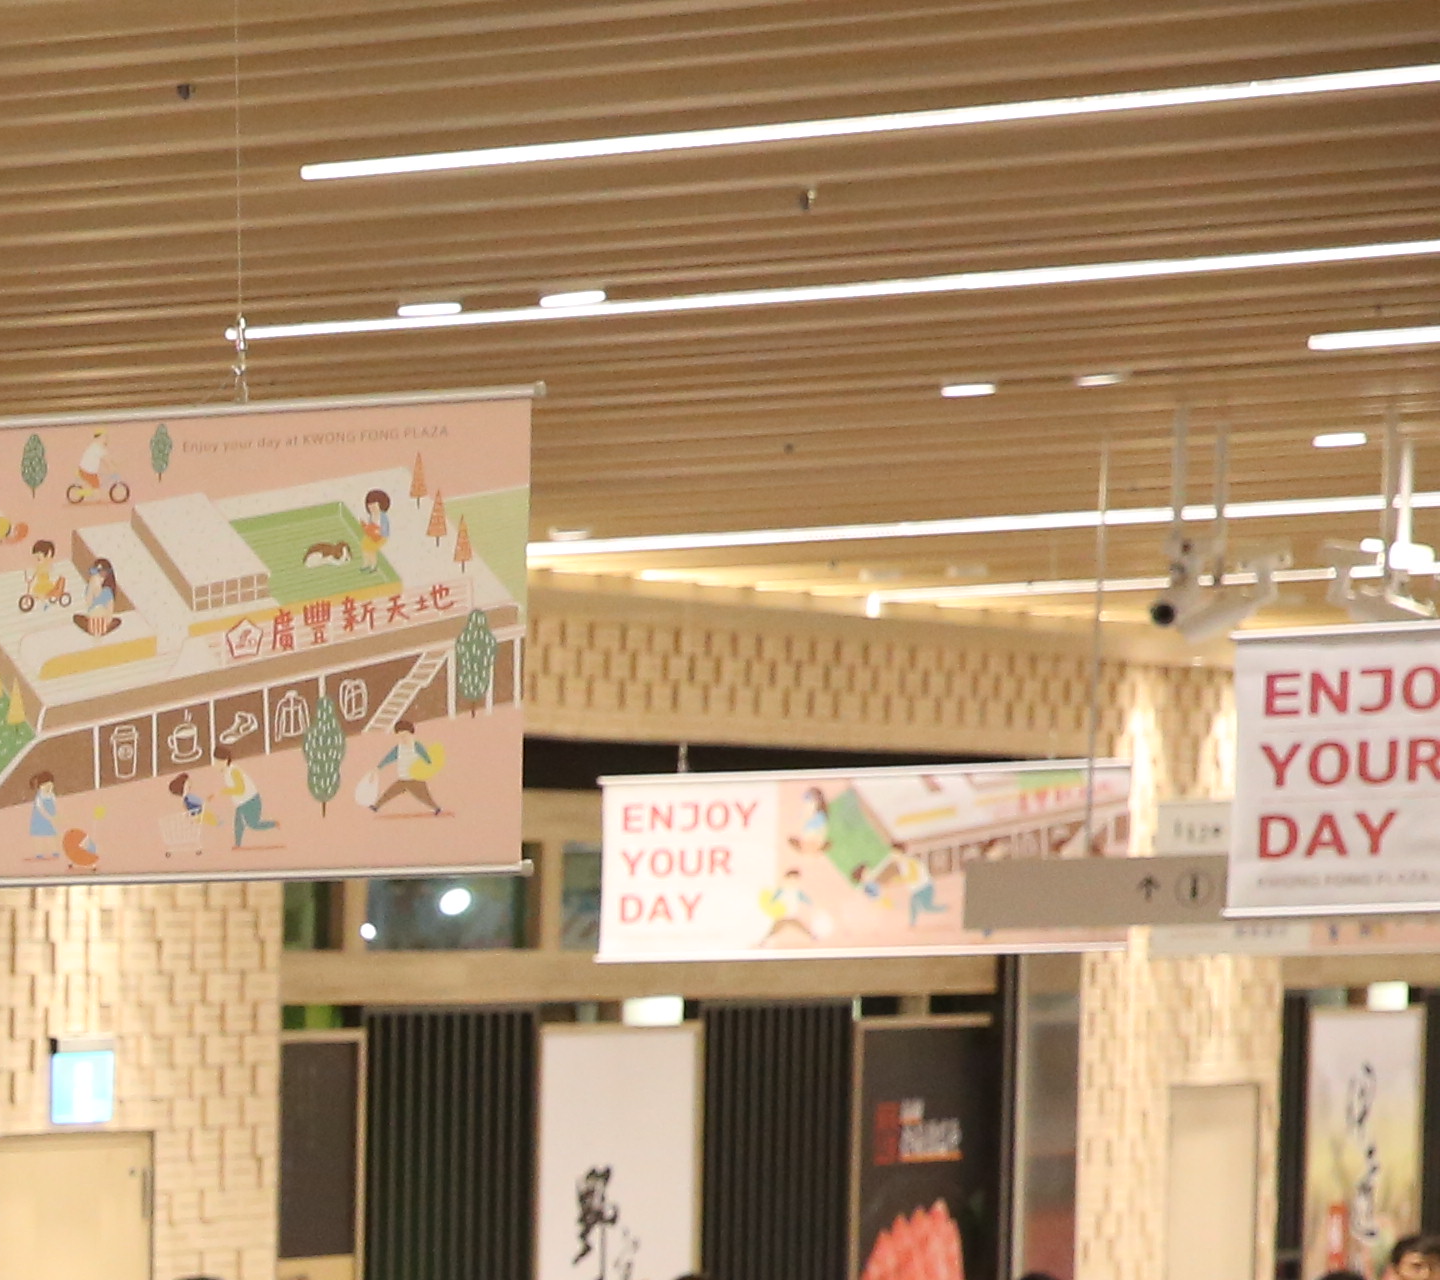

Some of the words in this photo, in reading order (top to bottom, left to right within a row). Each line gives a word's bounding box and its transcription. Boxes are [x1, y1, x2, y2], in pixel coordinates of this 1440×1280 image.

[182, 439, 220, 453] Enjoy
[223, 439, 254, 452] your
[257, 435, 281, 450] day
[285, 436, 298, 446] at
[302, 429, 356, 446] KWONG
[361, 427, 400, 443] FONG
[403, 425, 449, 439] PLAZA
[272, 583, 454, 651] 廣豐新天地
[1260, 735, 1440, 788] YOUR
[621, 800, 759, 834] ENJOY
[1257, 808, 1398, 859] DAY
[620, 846, 734, 878] YOUR
[619, 891, 704, 925] DAY
